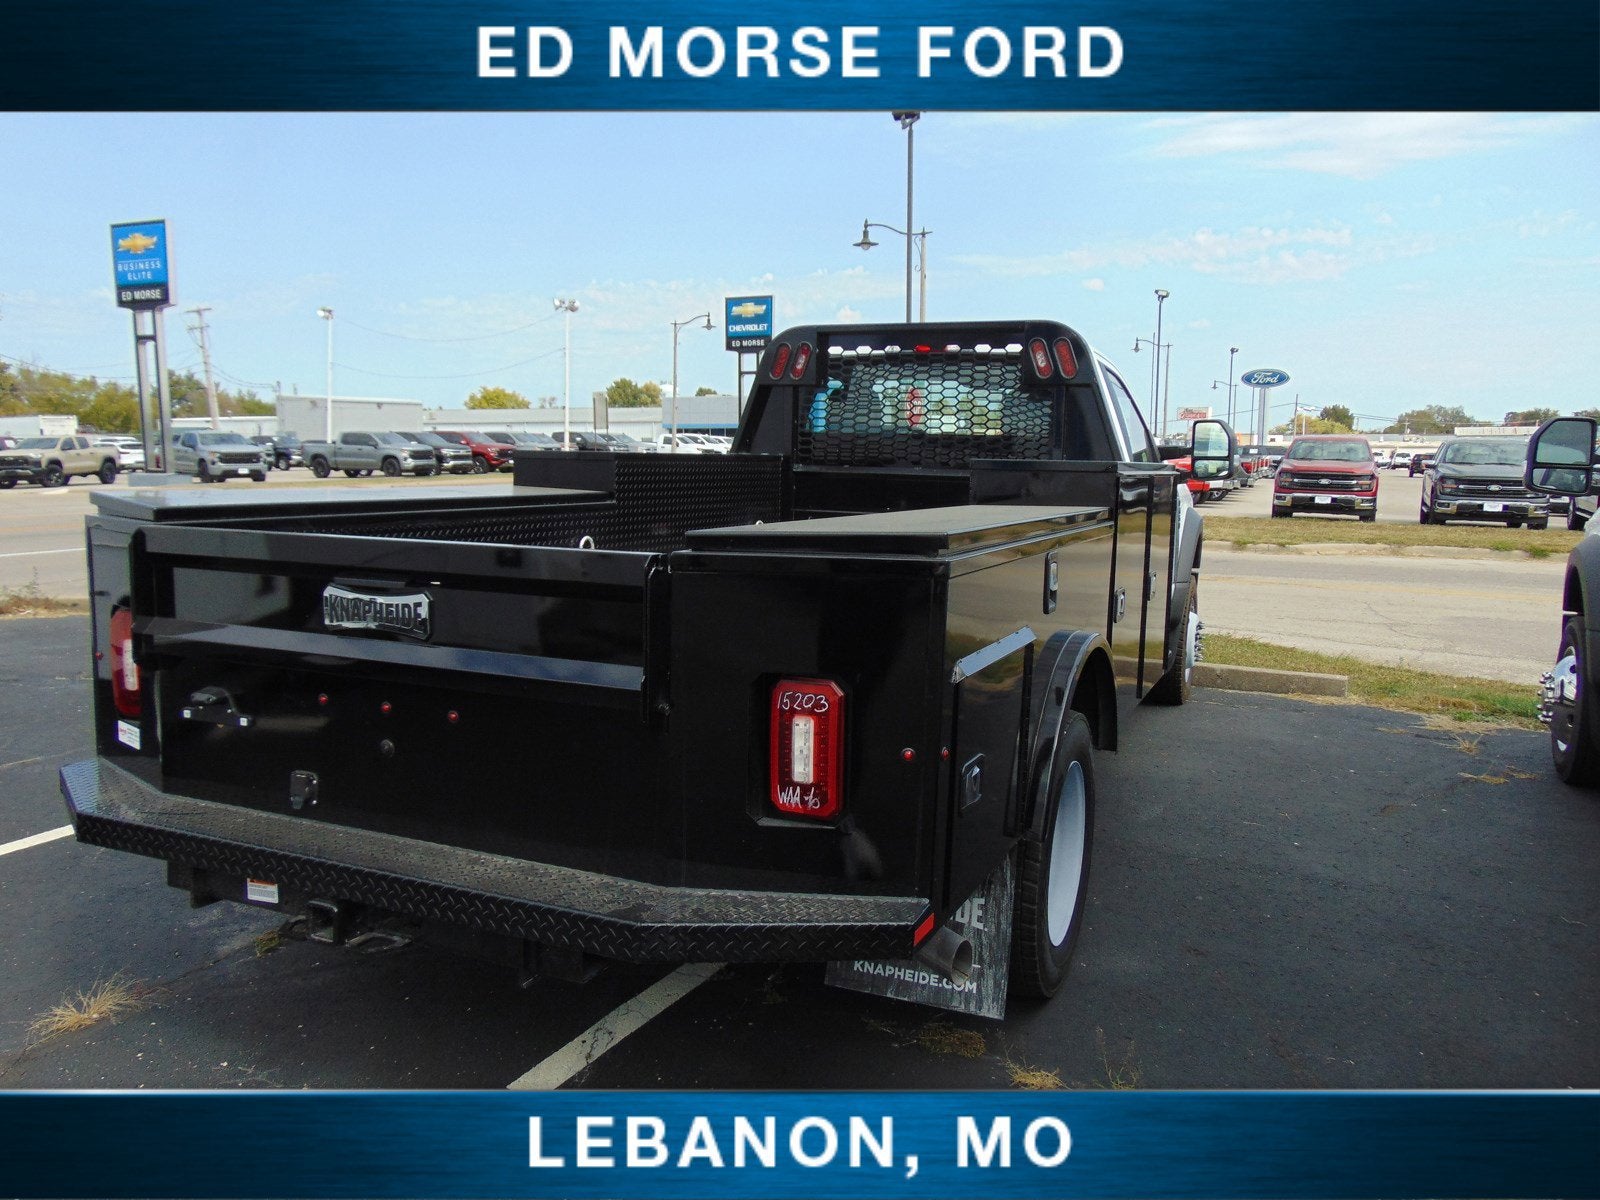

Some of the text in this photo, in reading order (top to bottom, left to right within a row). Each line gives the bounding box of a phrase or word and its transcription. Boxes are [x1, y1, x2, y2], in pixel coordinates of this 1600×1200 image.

[117, 260, 161, 272] BUSINESS
[127, 271, 152, 281] ELITE
[121, 289, 161, 301] ED MORSE
[729, 323, 768, 332] CHEVROLET
[742, 339, 765, 347] MORSE
[1251, 372, 1280, 384] Ford
[327, 594, 423, 625] KNAPHEIDE
